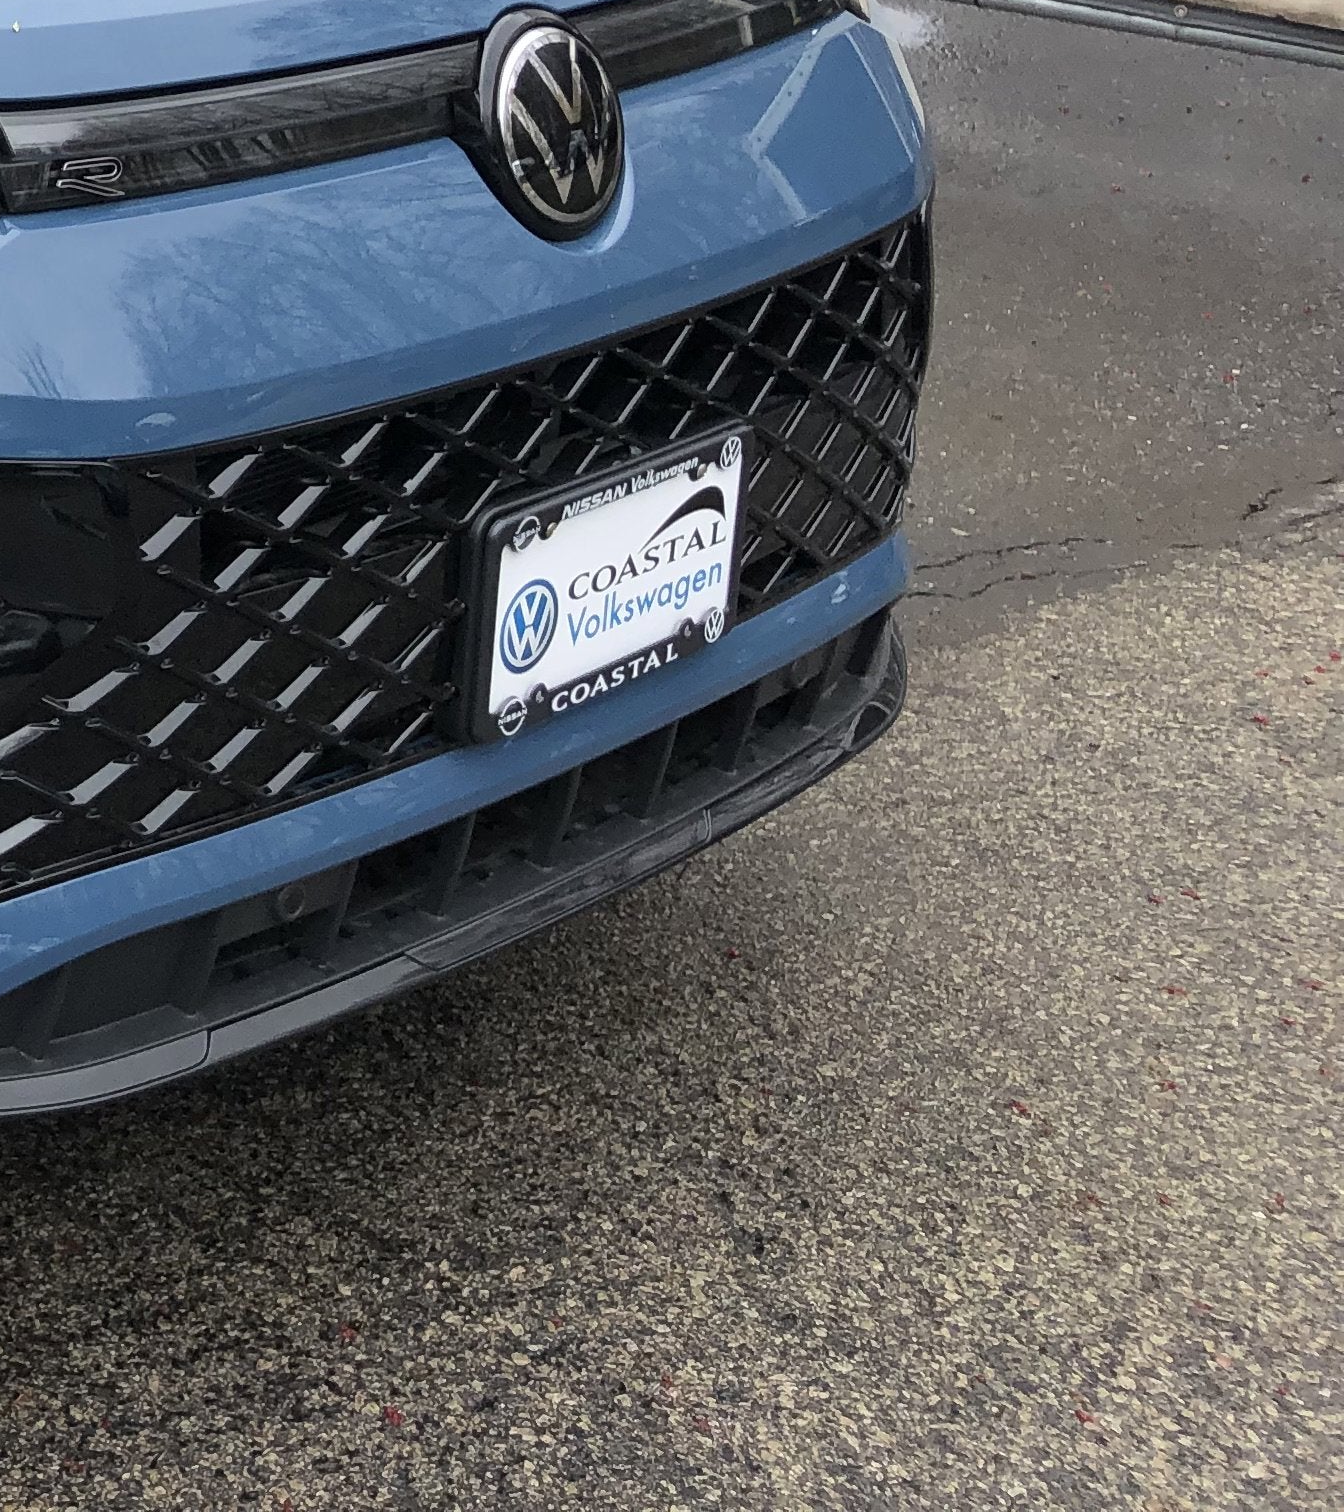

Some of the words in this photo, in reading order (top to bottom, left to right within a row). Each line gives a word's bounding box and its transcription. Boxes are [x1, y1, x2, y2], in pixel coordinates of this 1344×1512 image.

[561, 482, 627, 520] NISSAN
[631, 456, 699, 493] Volkswagen
[568, 520, 727, 600] COASTAL
[567, 562, 722, 646] Volkswagen
[551, 642, 679, 712] COASTAL
